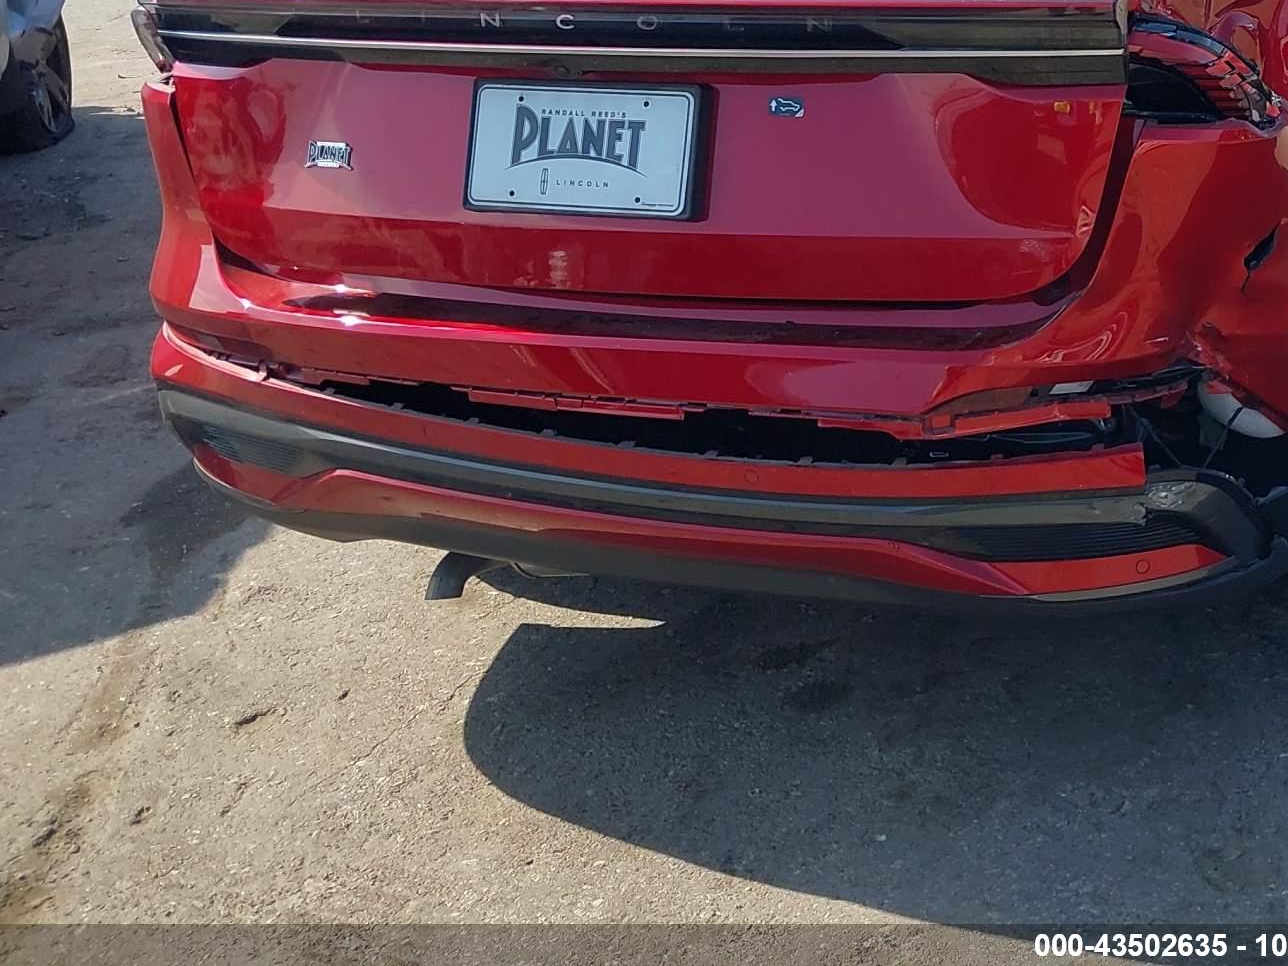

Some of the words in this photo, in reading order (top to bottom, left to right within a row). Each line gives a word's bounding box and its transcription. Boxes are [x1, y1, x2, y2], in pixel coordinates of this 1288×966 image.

[541, 108, 585, 117] RANDALL
[591, 110, 627, 118] REED'S
[510, 103, 646, 169] PLANET
[307, 139, 350, 166] PLANET
[556, 179, 609, 188] LINCOLN
